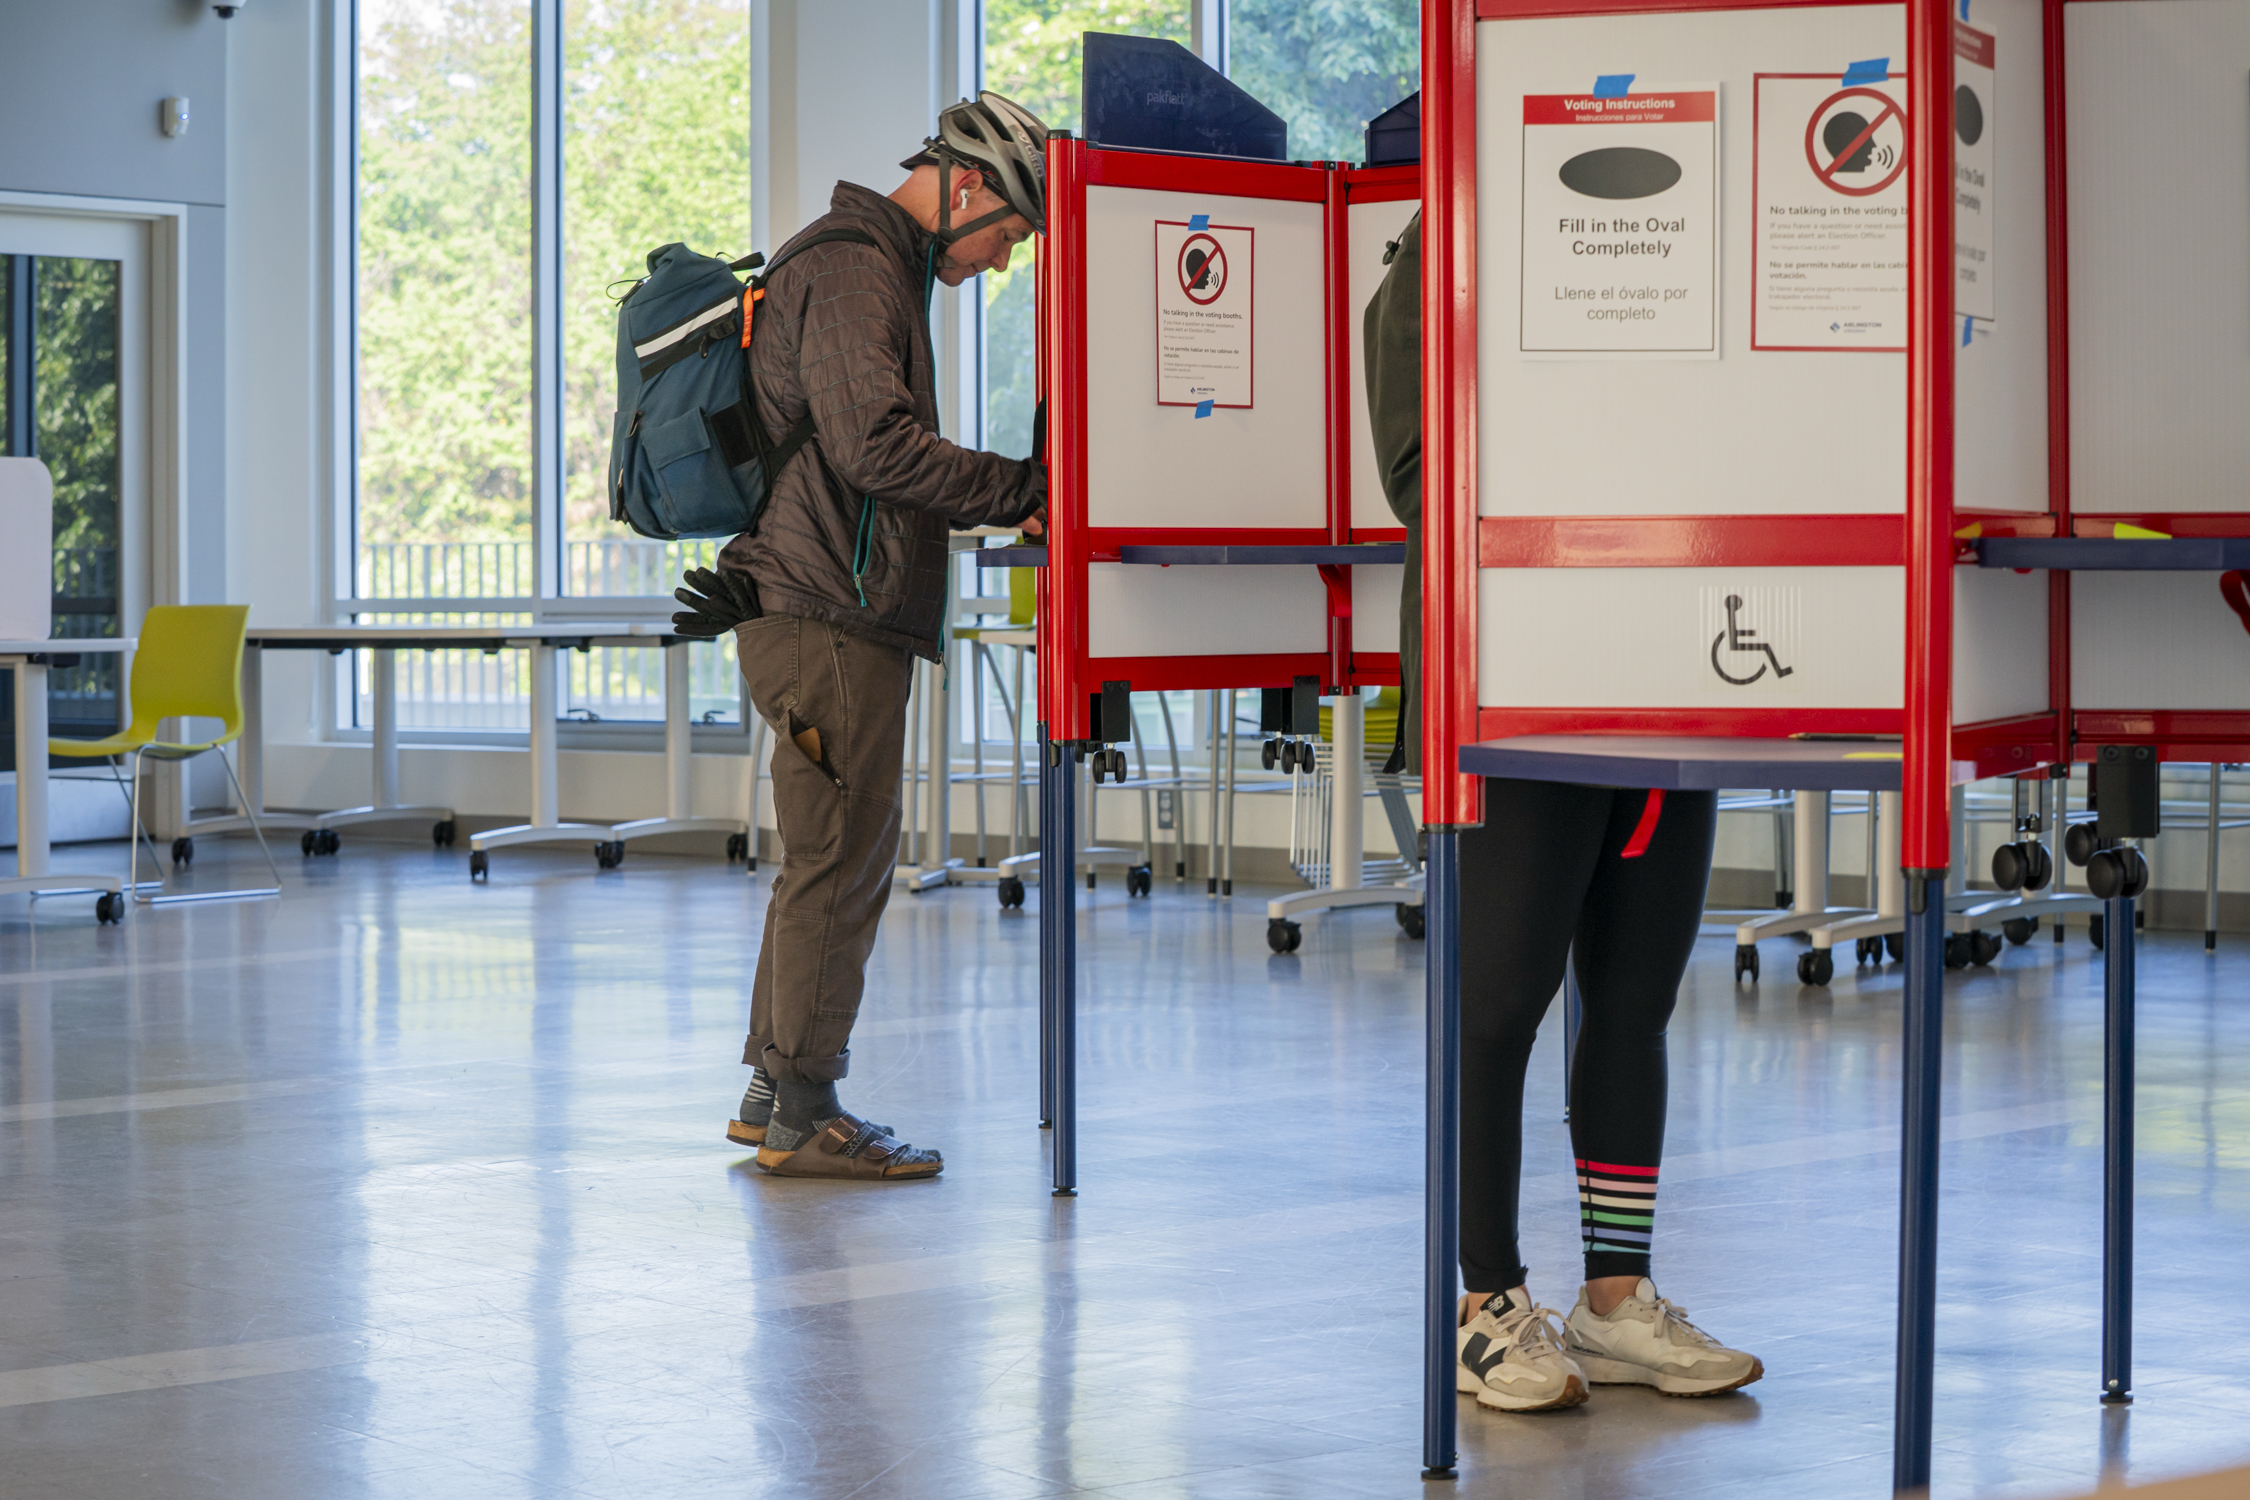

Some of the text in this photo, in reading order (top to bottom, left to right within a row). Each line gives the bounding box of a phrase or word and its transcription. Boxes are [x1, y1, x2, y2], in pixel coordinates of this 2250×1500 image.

[1564, 97, 1675, 112] Voting Instructions
[1575, 113, 1664, 122] Instrucciones para Votar
[1770, 206, 1785, 215] No
[1788, 206, 1827, 217] talking
[1830, 206, 1839, 215] in
[1843, 206, 1861, 215] the
[1864, 206, 1897, 217] voting
[1559, 217, 1685, 233] Fill in the Oval
[1572, 240, 1672, 258] Completely
[1769, 261, 1782, 269] No
[1796, 261, 1829, 270] permite
[1831, 261, 1858, 269] hablar
[1873, 261, 1885, 269] las
[1769, 272, 1807, 280] votación.
[1555, 285, 1688, 303] Llene el óvalo por
[1587, 306, 1656, 323] completo
